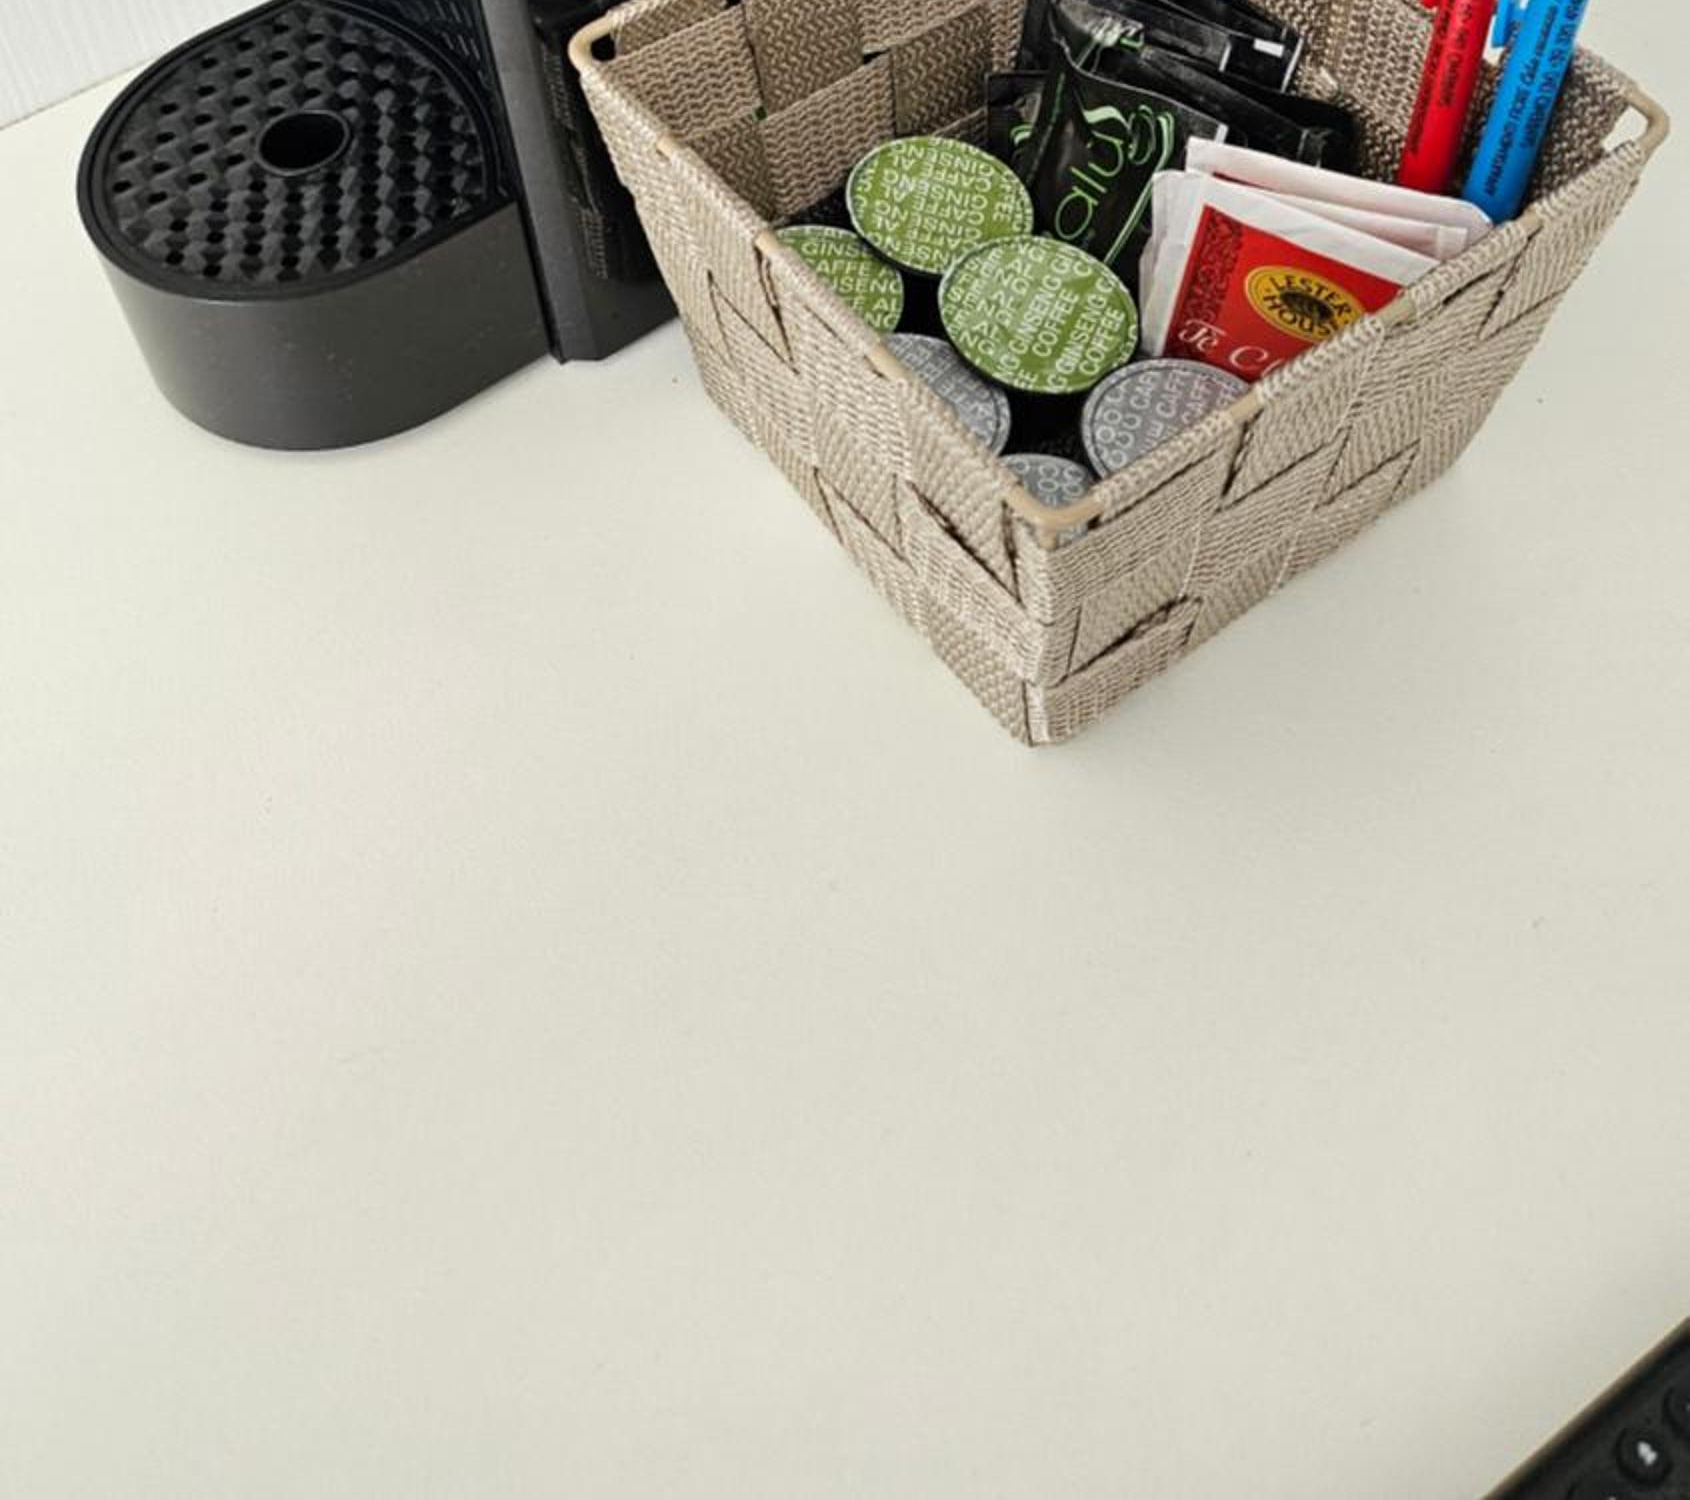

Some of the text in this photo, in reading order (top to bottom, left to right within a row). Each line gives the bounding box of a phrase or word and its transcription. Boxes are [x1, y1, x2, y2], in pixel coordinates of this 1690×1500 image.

[880, 182, 908, 202] AL
[882, 167, 989, 211] GINSENG
[912, 195, 986, 226] CAFFE
[874, 198, 983, 241] GINSENG
[800, 241, 861, 258] GINS
[865, 231, 957, 265] NSENG
[1008, 275, 1063, 356] GINSENG
[1269, 274, 1352, 318] LESTER
[1031, 287, 1081, 358] COFFEE
[1055, 293, 1108, 375] GINSENG
[1079, 306, 1127, 376] COFFEE
